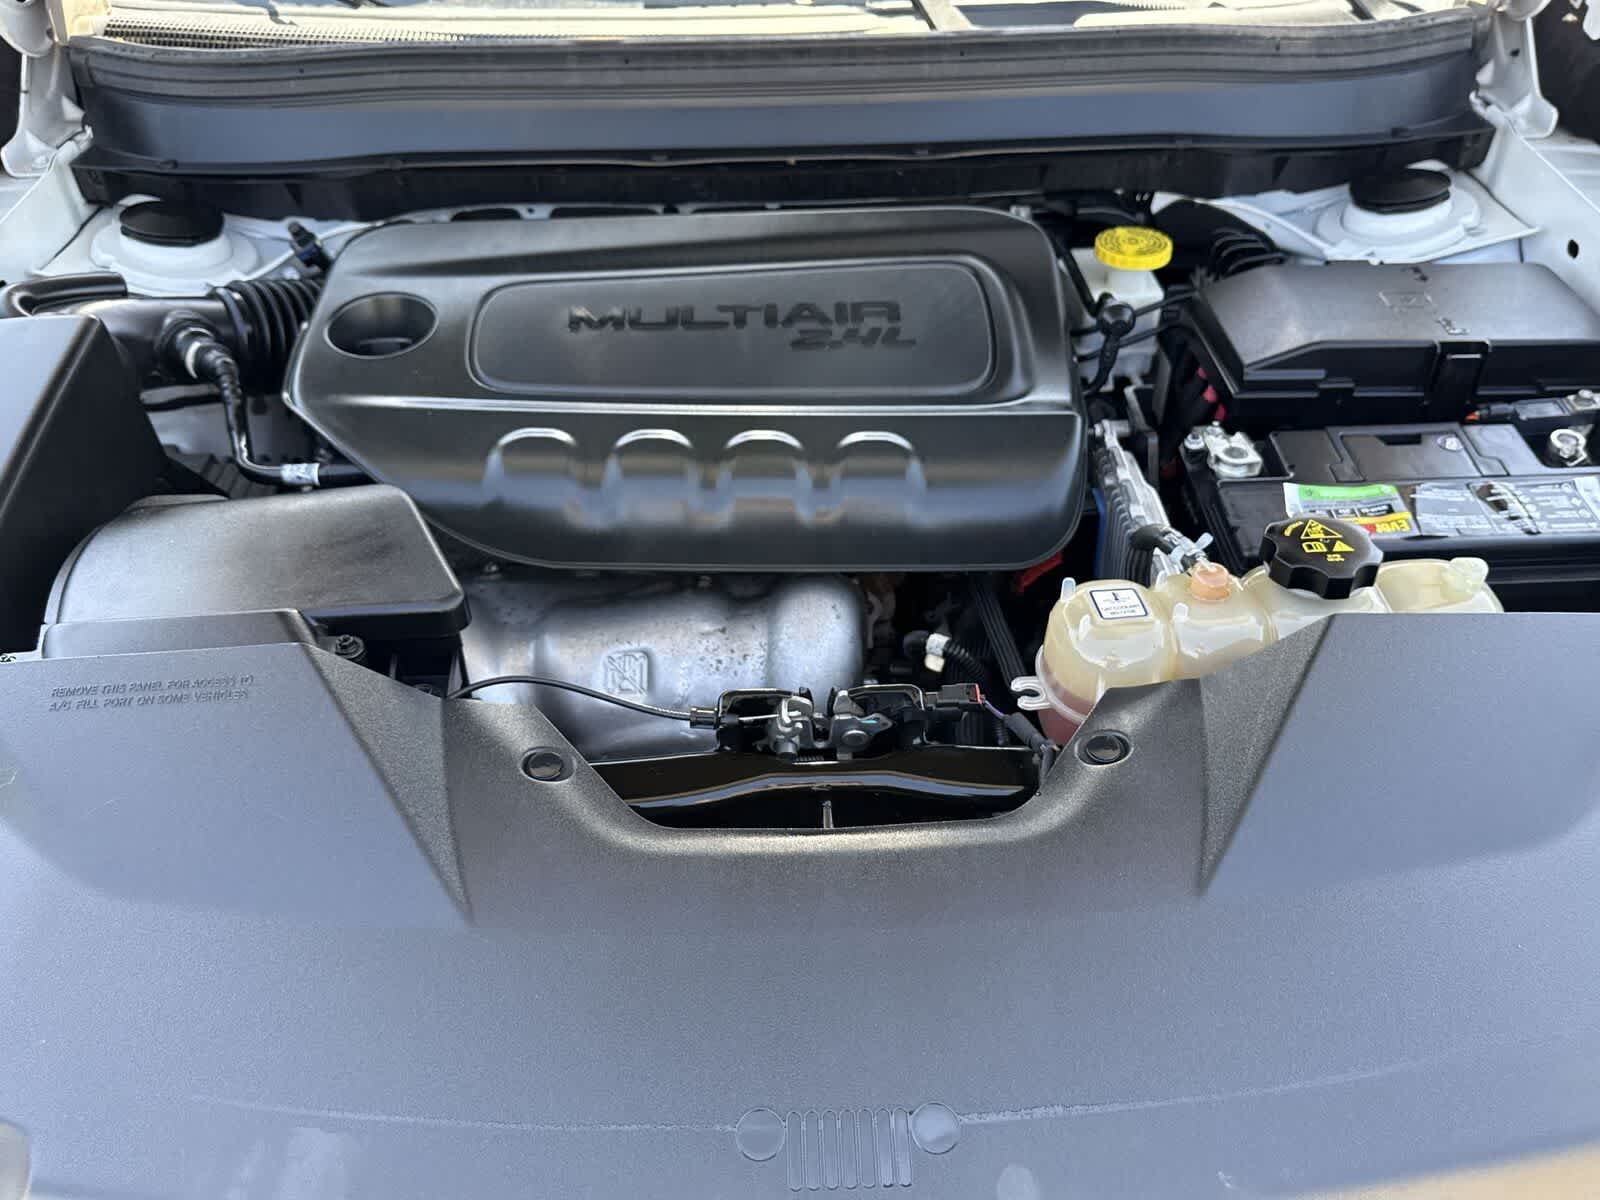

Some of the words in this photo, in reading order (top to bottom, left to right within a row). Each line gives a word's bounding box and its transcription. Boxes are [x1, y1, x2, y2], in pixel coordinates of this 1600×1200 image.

[568, 301, 901, 332] MULTIAIR
[52, 685, 98, 697] REMOVE
[102, 683, 127, 694] THIS
[129, 681, 162, 692] PANEL
[167, 680, 191, 690] FOR
[76, 698, 100, 710] FILL
[103, 697, 133, 708] PORT
[136, 695, 155, 705] ON
[158, 694, 189, 705] SOME
